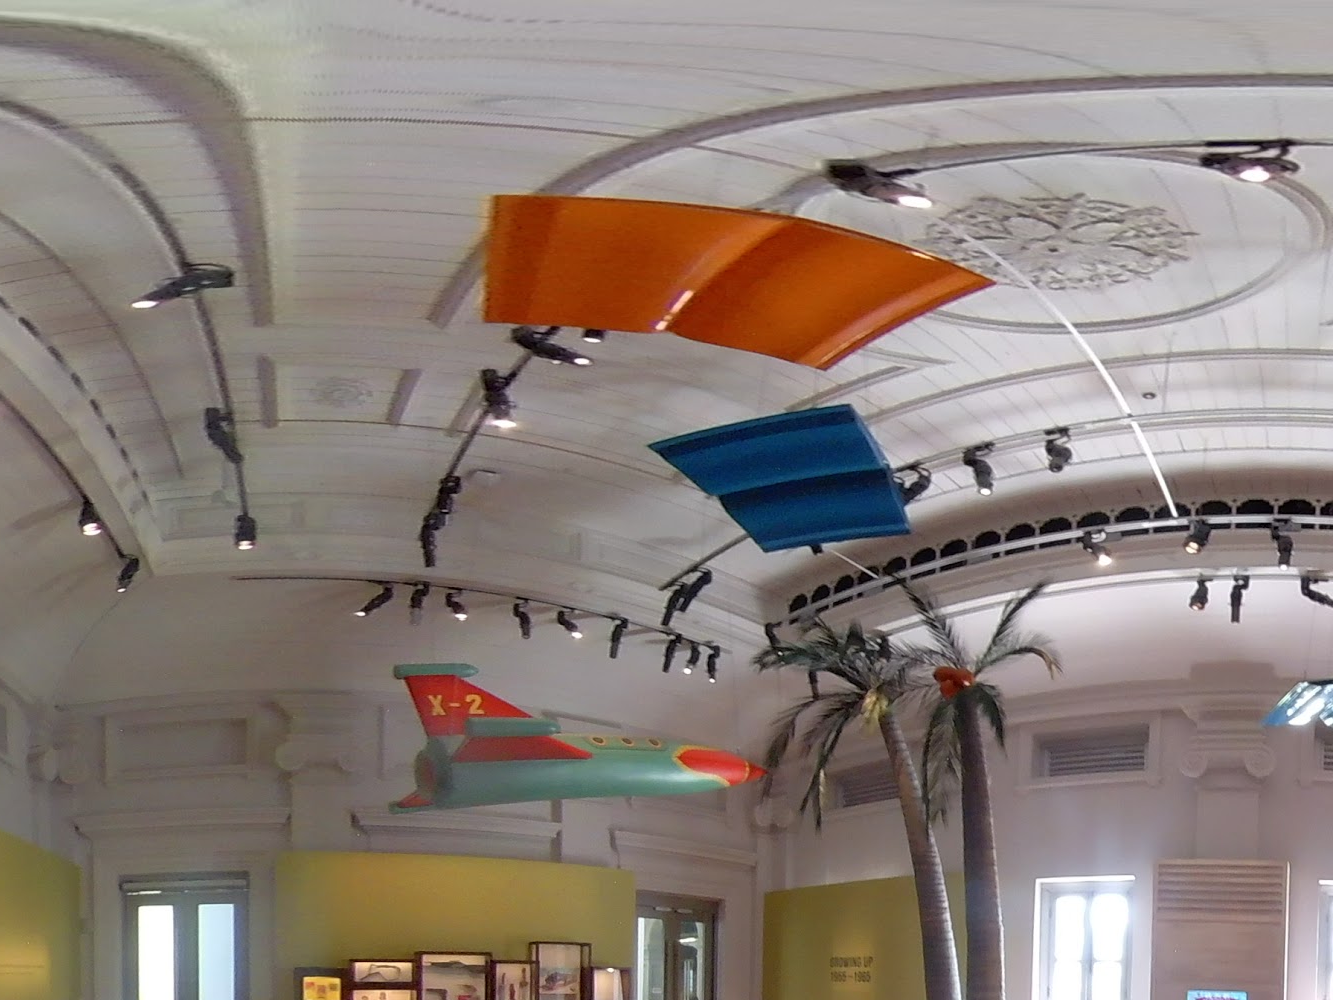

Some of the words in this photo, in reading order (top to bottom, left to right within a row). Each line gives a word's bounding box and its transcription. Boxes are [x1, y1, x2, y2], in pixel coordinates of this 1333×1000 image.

[427, 694, 485, 716] X-2
[829, 956, 862, 968] GROWING
[863, 956, 874, 968] UP
